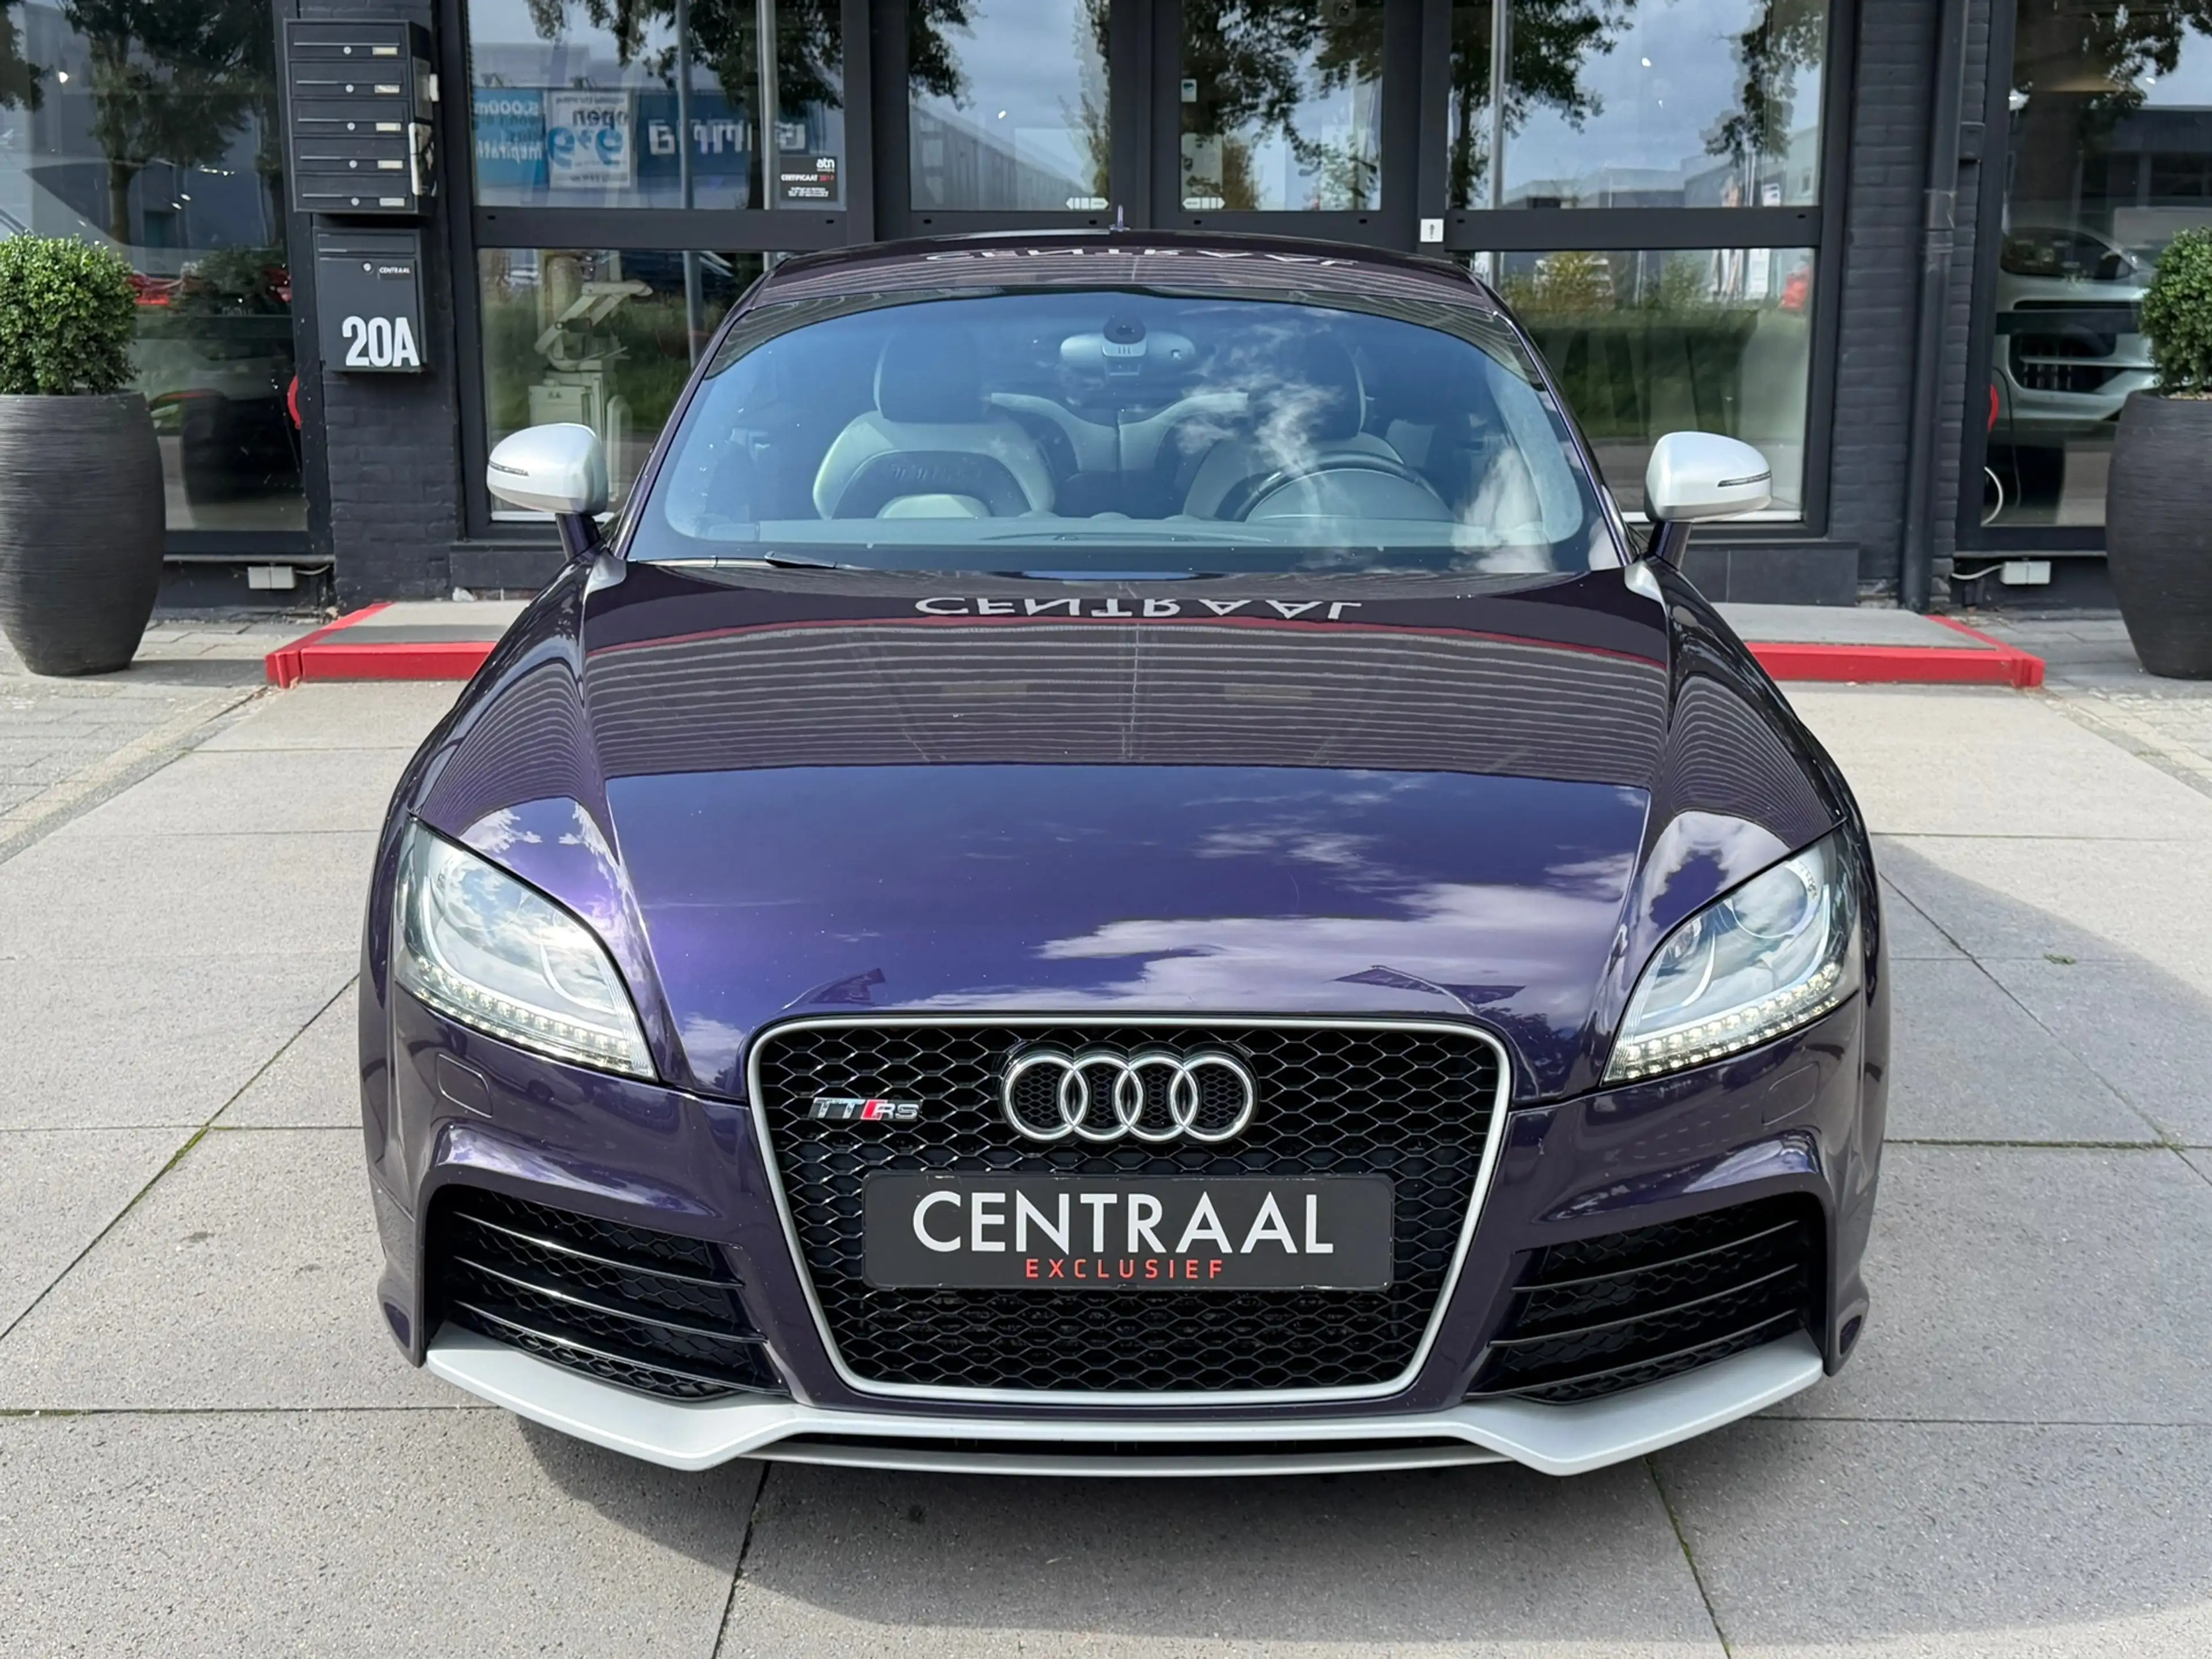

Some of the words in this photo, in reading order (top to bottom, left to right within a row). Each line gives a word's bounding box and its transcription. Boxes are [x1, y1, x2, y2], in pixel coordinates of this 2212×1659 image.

[816, 158, 835, 168] atn
[342, 315, 420, 368] 20A
[913, 1190, 1334, 1255] CENTRAAL
[1027, 1259, 1224, 1279] EXCLUSIEF
